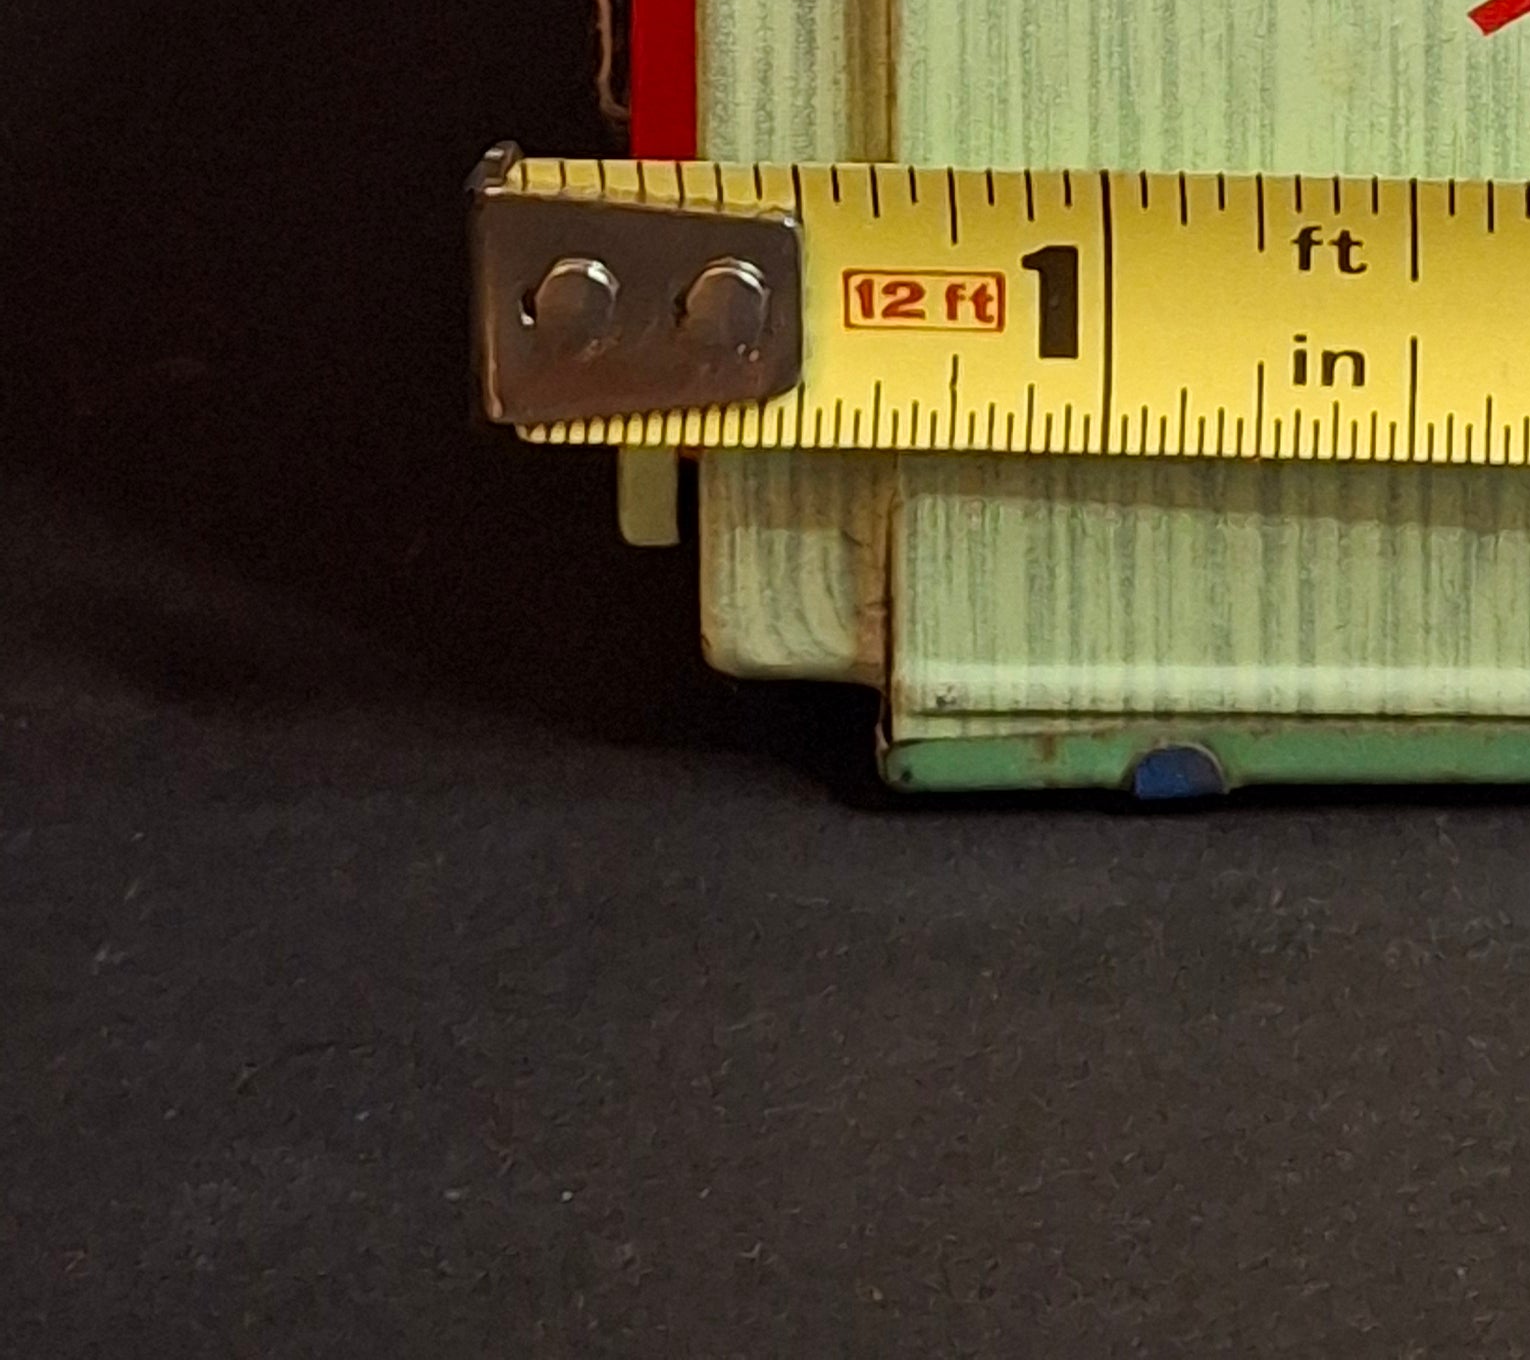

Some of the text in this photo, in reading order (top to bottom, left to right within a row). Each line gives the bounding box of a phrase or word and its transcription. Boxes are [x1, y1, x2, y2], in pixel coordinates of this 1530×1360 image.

[1291, 224, 1369, 275] ft
[855, 278, 995, 324] 12 ft
[1020, 244, 1080, 360] 1
[1293, 334, 1367, 387] in
